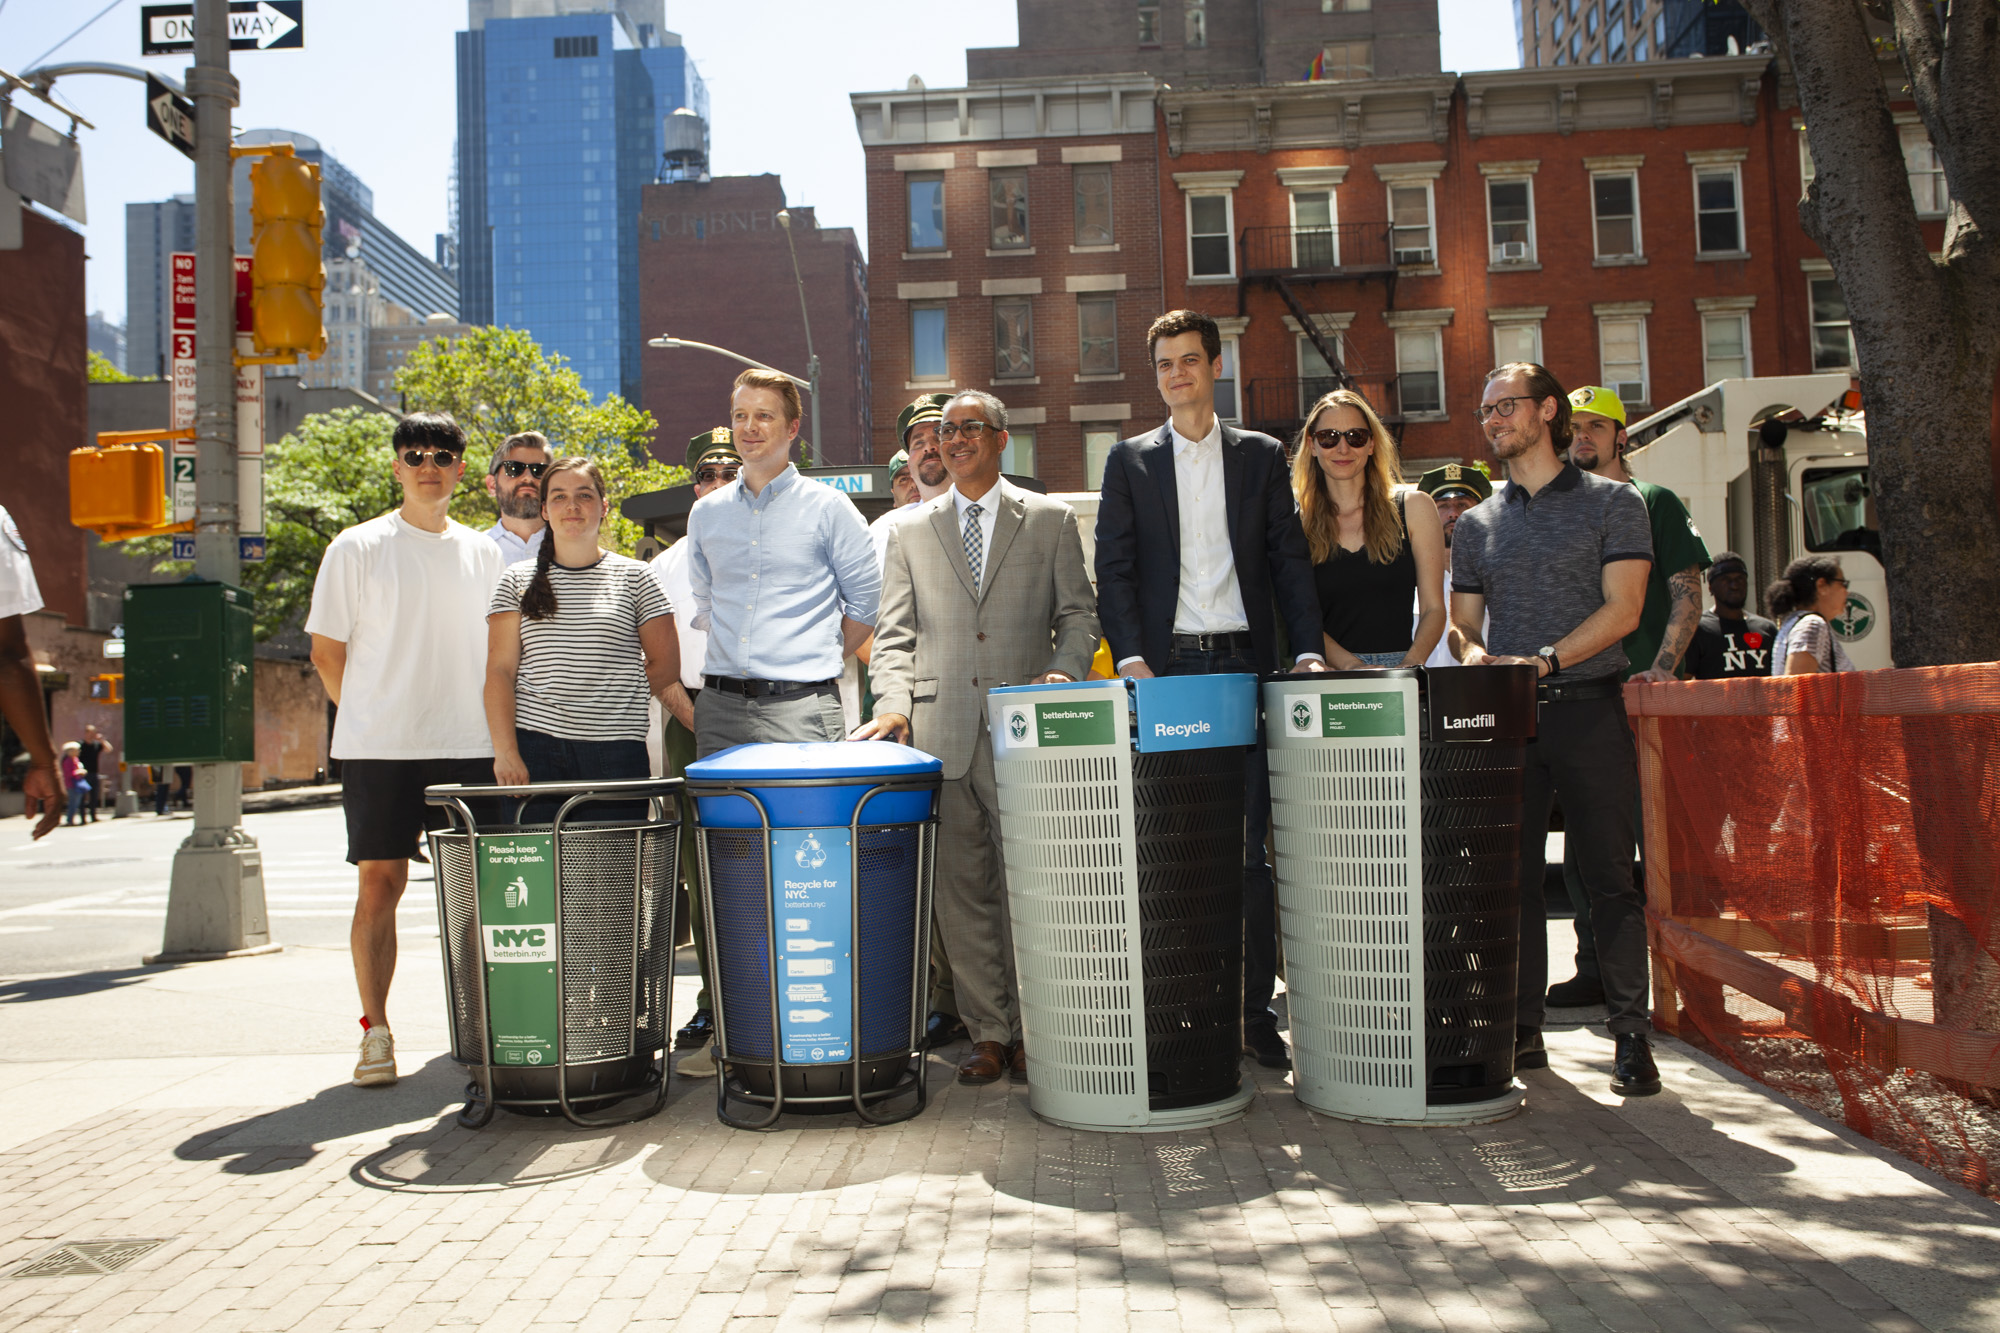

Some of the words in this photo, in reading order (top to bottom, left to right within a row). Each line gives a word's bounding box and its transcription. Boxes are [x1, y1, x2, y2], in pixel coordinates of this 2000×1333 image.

[164, 19, 195, 39] ON
[232, 16, 279, 36] WAY
[161, 102, 187, 137] ONE
[175, 258, 193, 270] NO
[177, 336, 192, 358] 3
[237, 380, 256, 389] NLY
[177, 459, 193, 482] 2
[815, 476, 863, 493] TAN
[1724, 633, 1738, 652] I
[1723, 649, 1768, 672] NY
[1328, 701, 1383, 711] betterbin.nyc
[1042, 711, 1094, 720] betterbin.nyc
[1443, 714, 1496, 730] Landfill
[1155, 720, 1211, 738] Recycle
[489, 846, 515, 854] Please
[516, 845, 538, 854] keep
[503, 855, 518, 865] city
[519, 855, 545, 863] clean.
[784, 880, 821, 891] Recycle
[823, 879, 838, 888] for
[785, 890, 810, 899] NYC.
[784, 901, 827, 909] betterbin.nyc
[492, 928, 546, 948] NYC
[493, 949, 547, 958] betterbin.nyc
[828, 1049, 845, 1057] NYC
